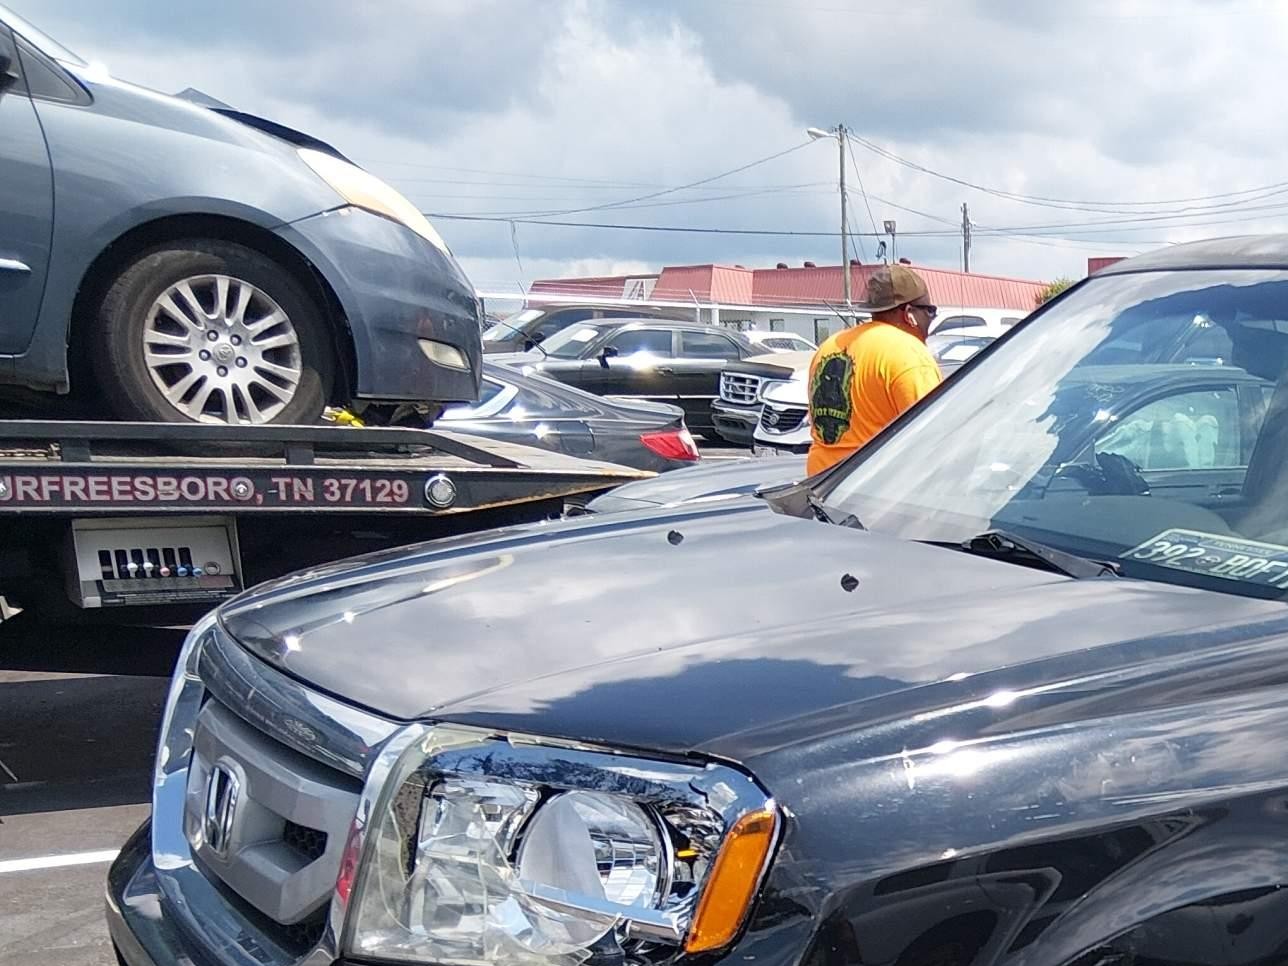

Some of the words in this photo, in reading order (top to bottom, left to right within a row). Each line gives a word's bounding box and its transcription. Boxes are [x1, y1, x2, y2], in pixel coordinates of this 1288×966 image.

[272, 477, 315, 501] TN
[323, 478, 409, 502] 37129
[1133, 541, 1206, 566] 392
